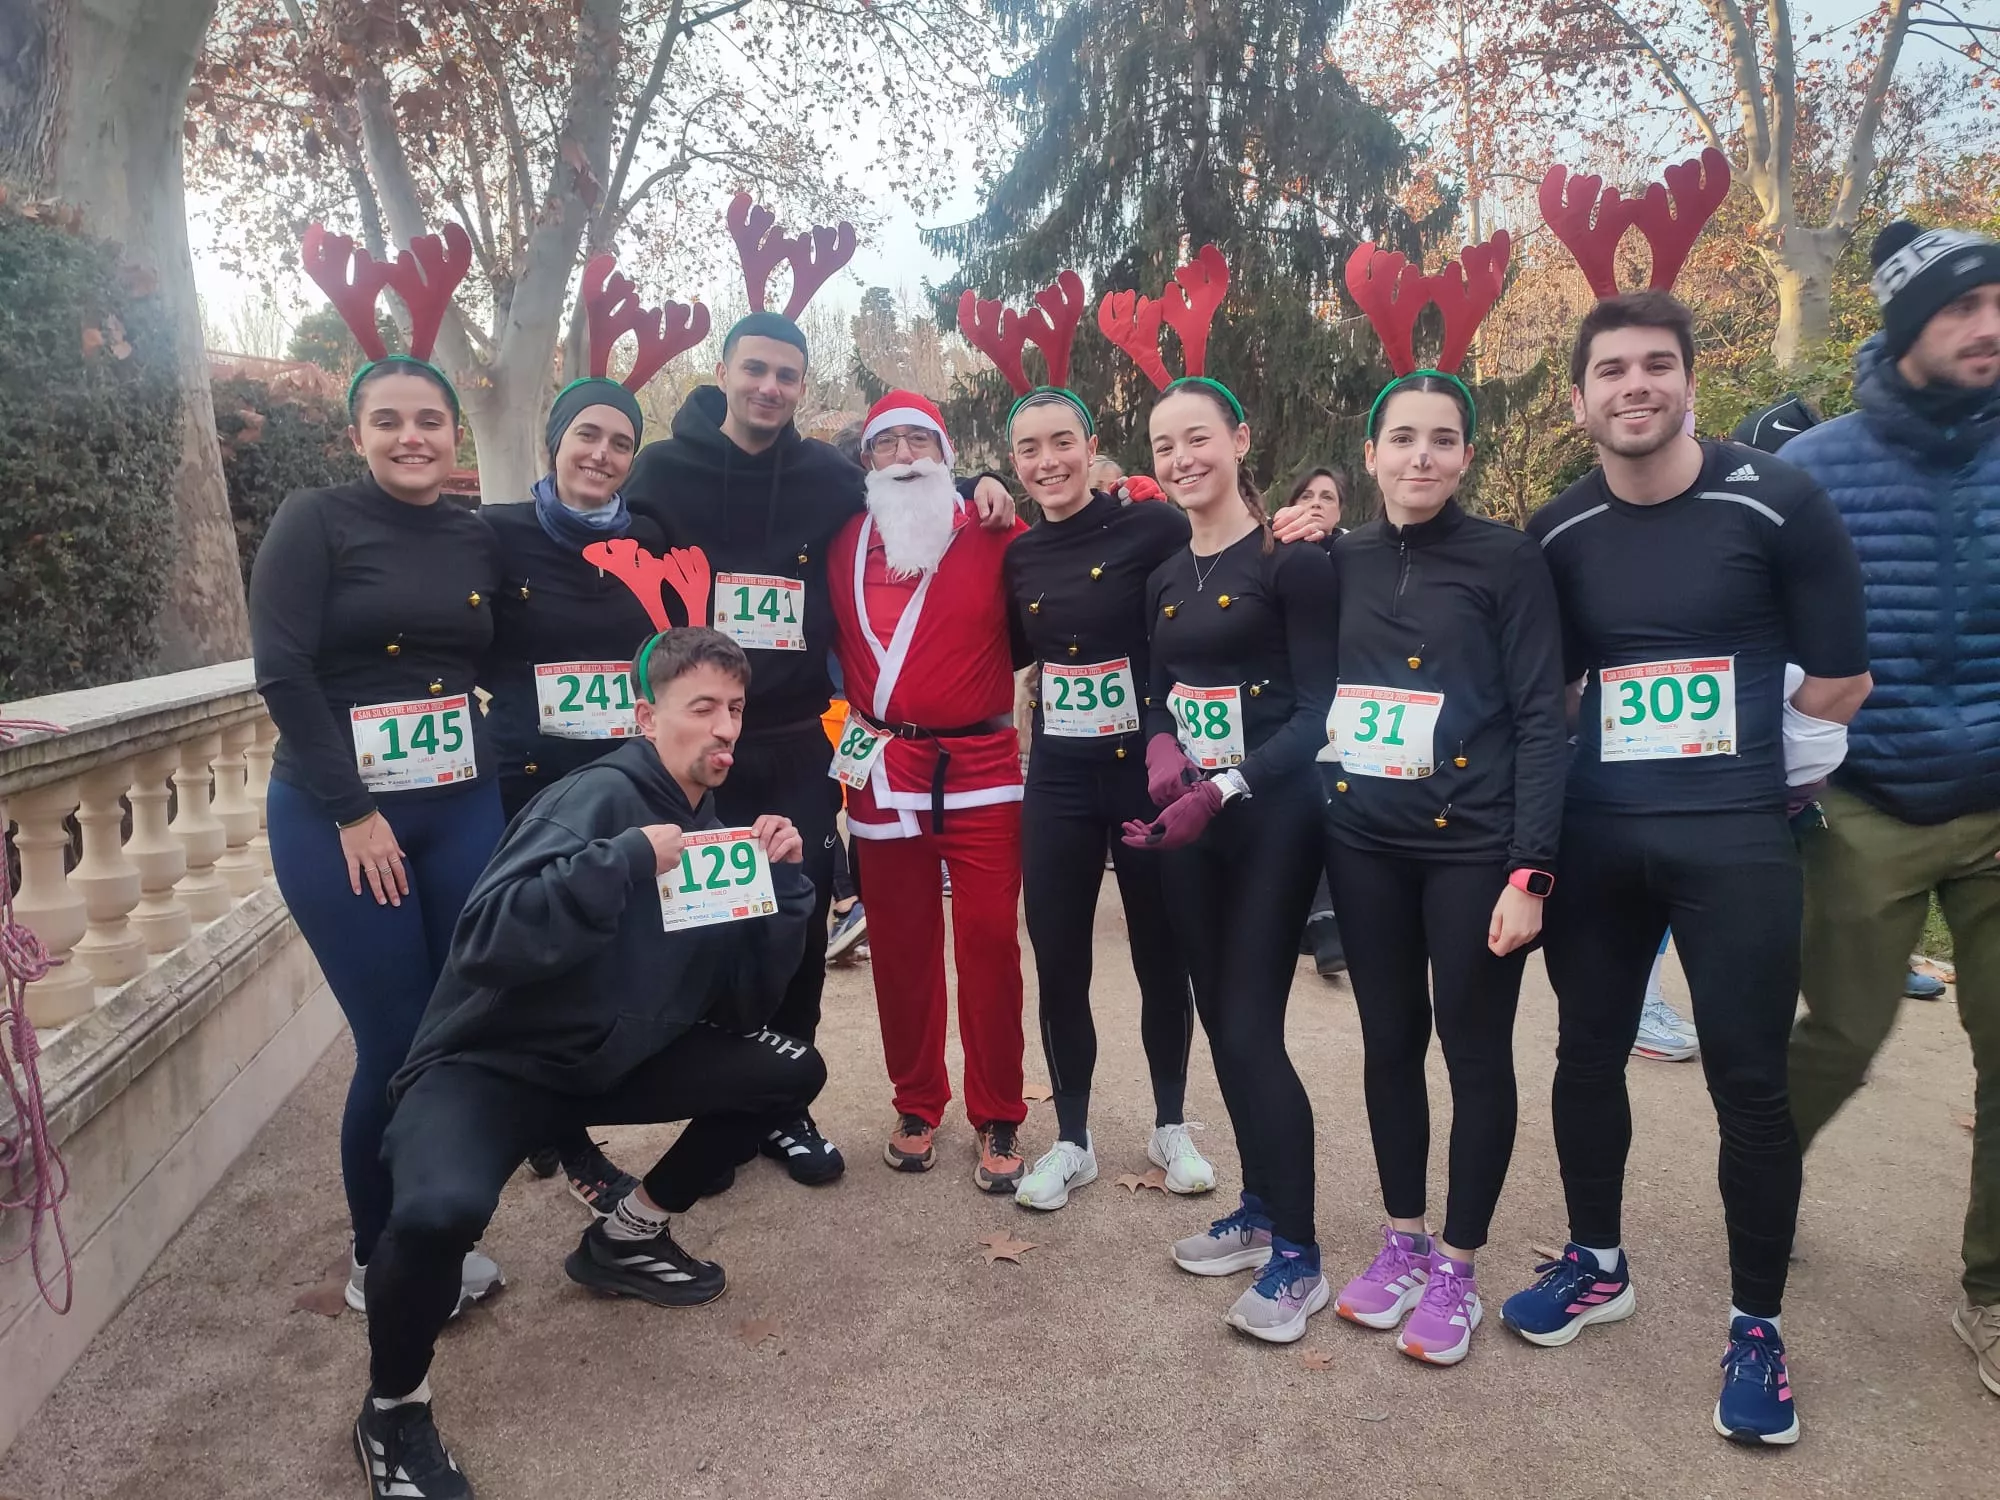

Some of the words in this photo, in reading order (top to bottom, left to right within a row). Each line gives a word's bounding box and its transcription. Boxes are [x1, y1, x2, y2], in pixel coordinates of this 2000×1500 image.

[734, 586, 797, 623] 141
[541, 666, 553, 675] SAN
[1674, 662, 1693, 673] 2025
[557, 674, 635, 712] 241
[1053, 672, 1125, 711] 236
[1395, 693, 1410, 701] 2025
[1619, 673, 1720, 726] 309
[358, 710, 371, 720] SAN
[372, 705, 406, 718] SILVESTRE
[407, 702, 430, 714] HUESCA
[1354, 700, 1406, 746] 31
[378, 710, 463, 761] 145
[841, 727, 879, 760] 89
[696, 835, 717, 845] HUESCA
[679, 841, 757, 894] 129
